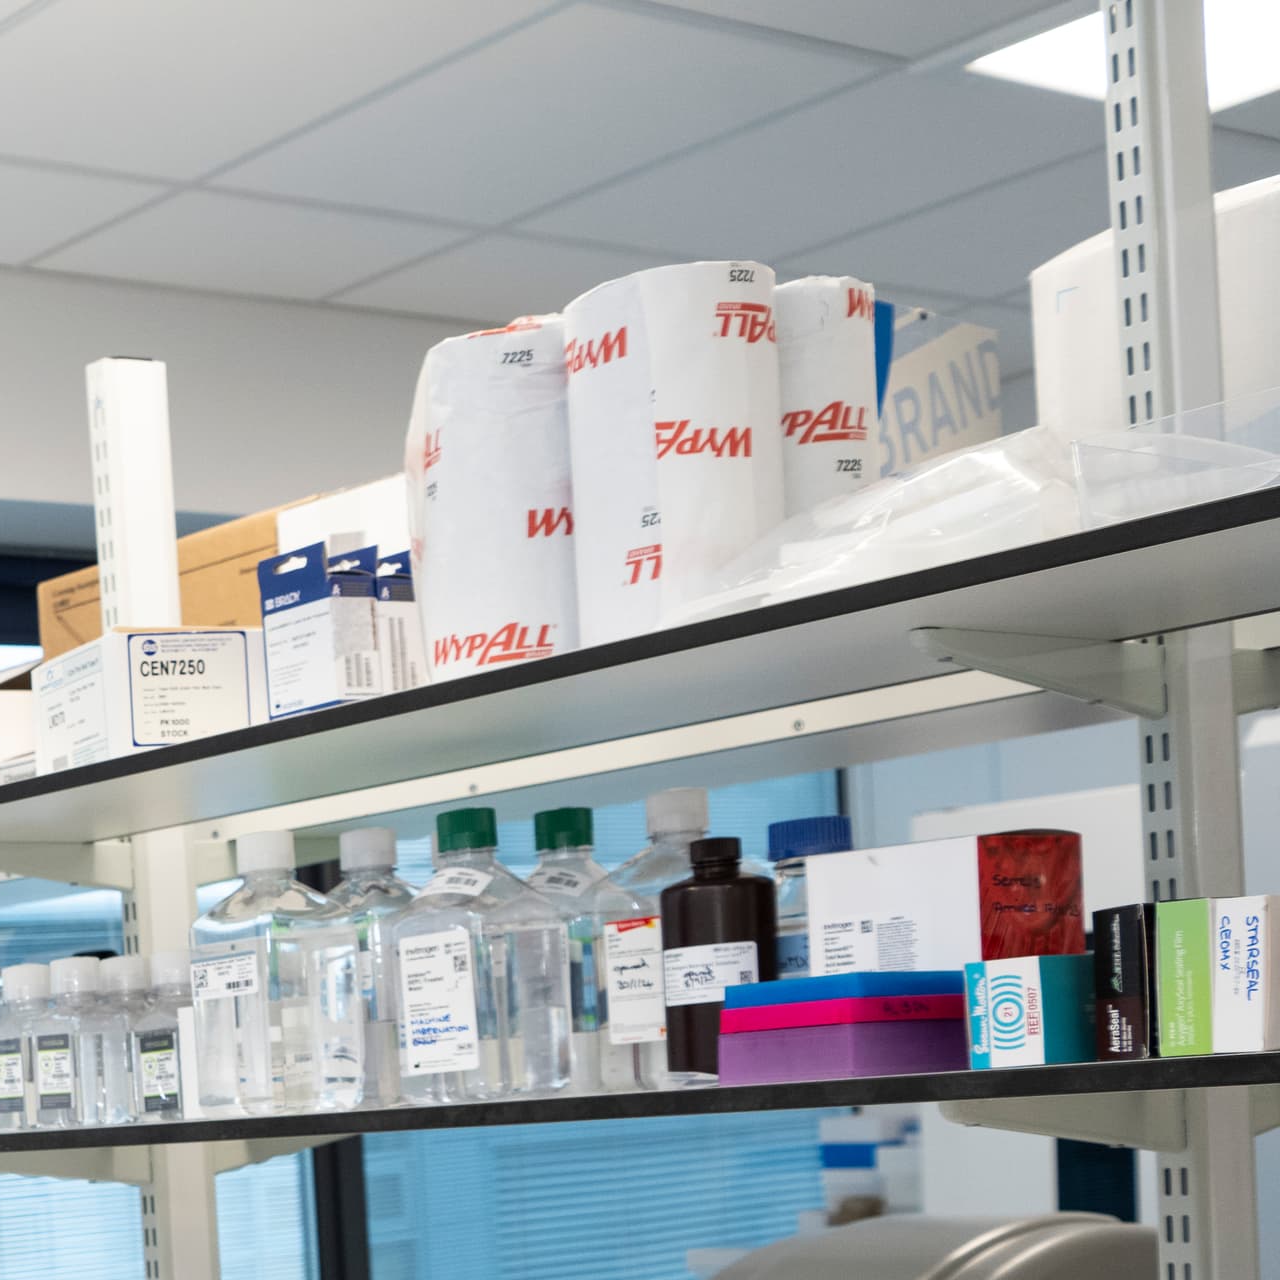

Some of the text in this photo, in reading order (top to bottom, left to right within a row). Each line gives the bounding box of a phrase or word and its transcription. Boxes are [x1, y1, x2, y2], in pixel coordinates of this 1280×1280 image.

[500, 350, 534, 365] 7225
[140, 659, 206, 677] CEN7250
[160, 729, 189, 738] STOCK
[1245, 915, 1261, 1001] STARSEAL
[1004, 1006, 1013, 1018] 21
[1027, 987, 1041, 1036] REF 0507
